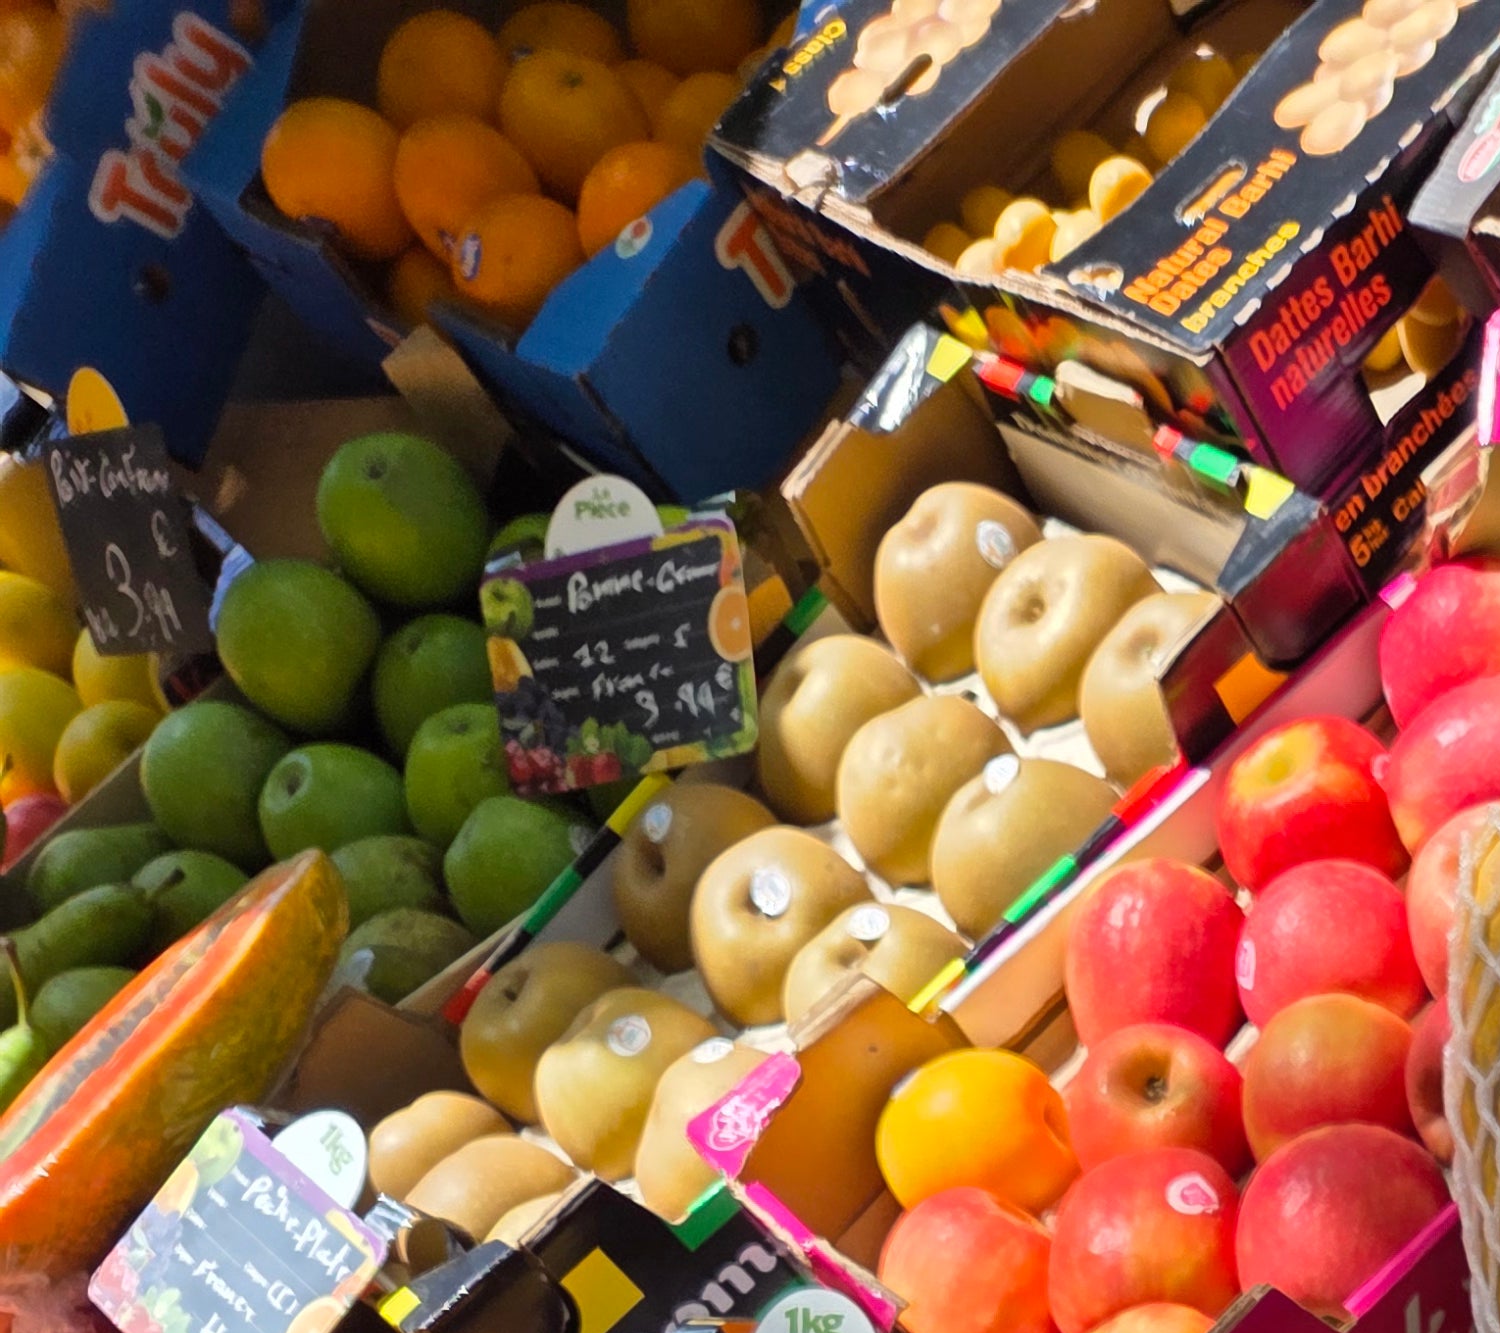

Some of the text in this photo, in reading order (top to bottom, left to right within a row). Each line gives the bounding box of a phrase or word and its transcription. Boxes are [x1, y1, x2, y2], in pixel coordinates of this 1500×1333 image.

[1123, 147, 1298, 305] Natural Barhi
[1148, 247, 1233, 317] Dates
[1180, 221, 1301, 334] branches
[1250, 193, 1404, 373] Dattes Barhi
[1270, 273, 1393, 411] naturelles
[1335, 494, 1366, 533] en
[319, 1122, 354, 1176] 1kg
